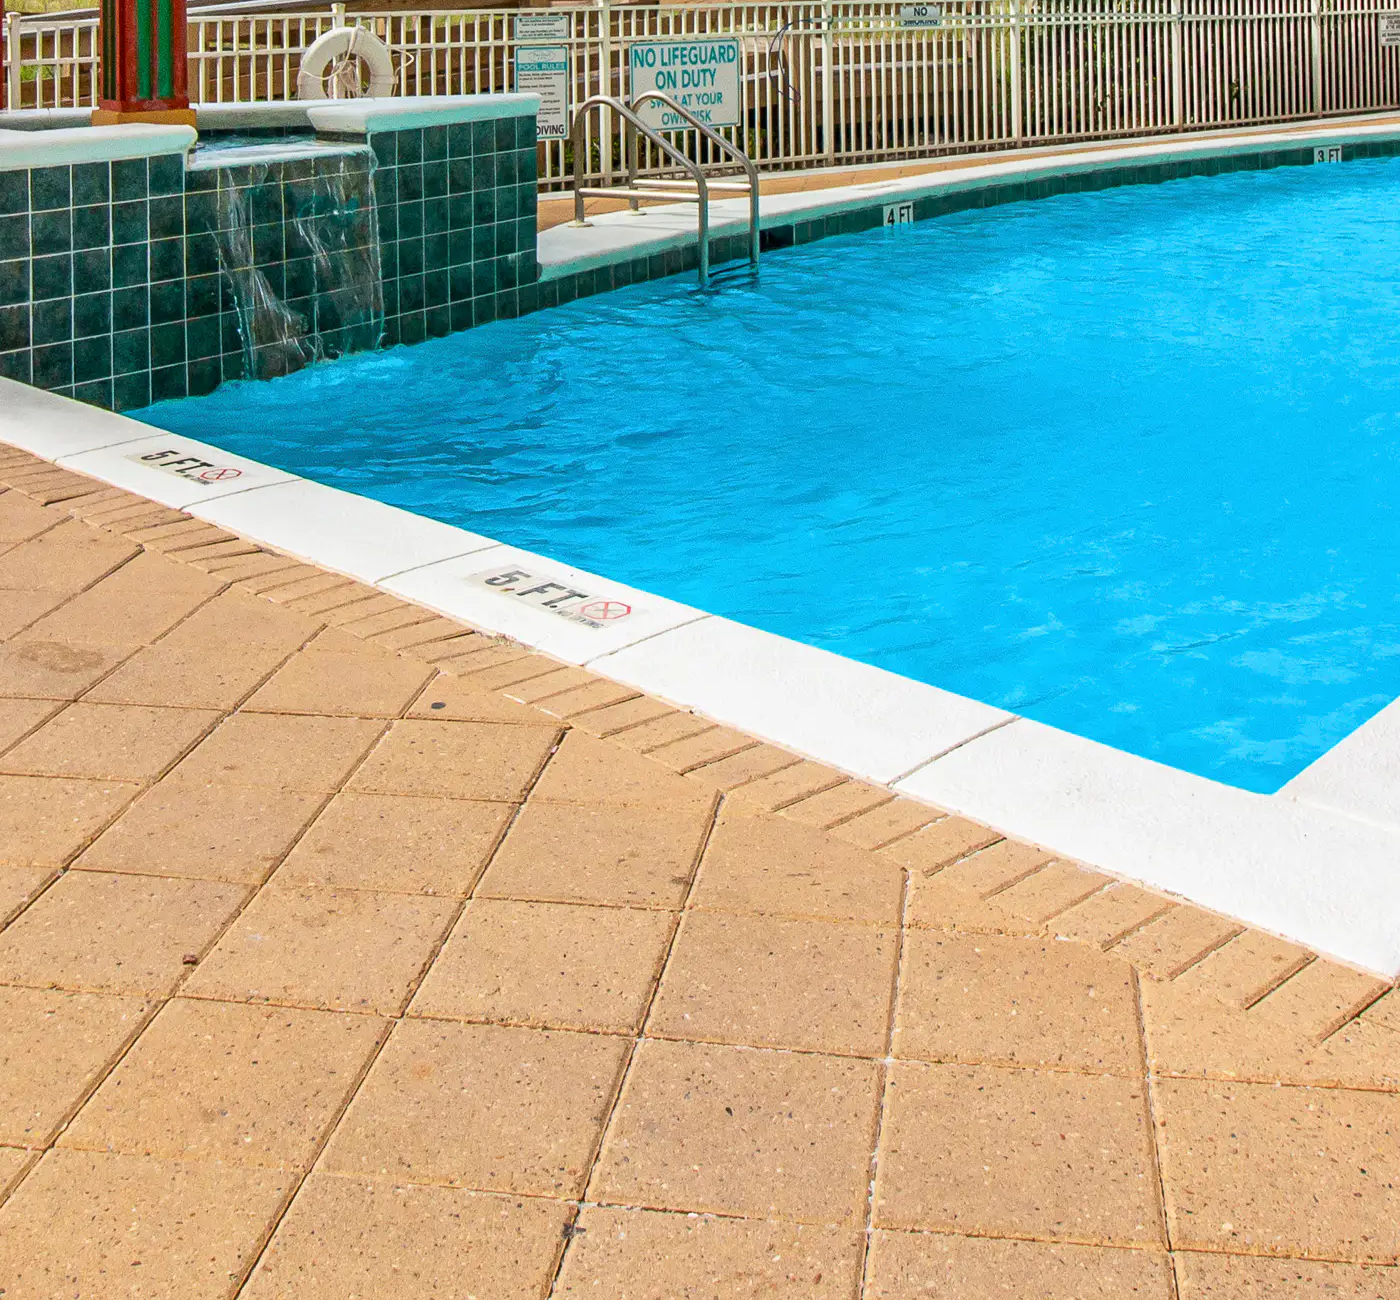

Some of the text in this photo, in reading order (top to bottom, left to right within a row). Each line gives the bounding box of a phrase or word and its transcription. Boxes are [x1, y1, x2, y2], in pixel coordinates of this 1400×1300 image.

[913, 7, 928, 17] NO
[634, 44, 736, 68] NO LIFEGUARD
[655, 68, 717, 90] ON DUTY
[681, 93, 693, 107] AT
[695, 92, 723, 105] YOUR
[1317, 148, 1341, 164] 3 FT
[887, 204, 912, 226] 4 FT
[140, 450, 180, 461] 5
[484, 570, 532, 587] 5
